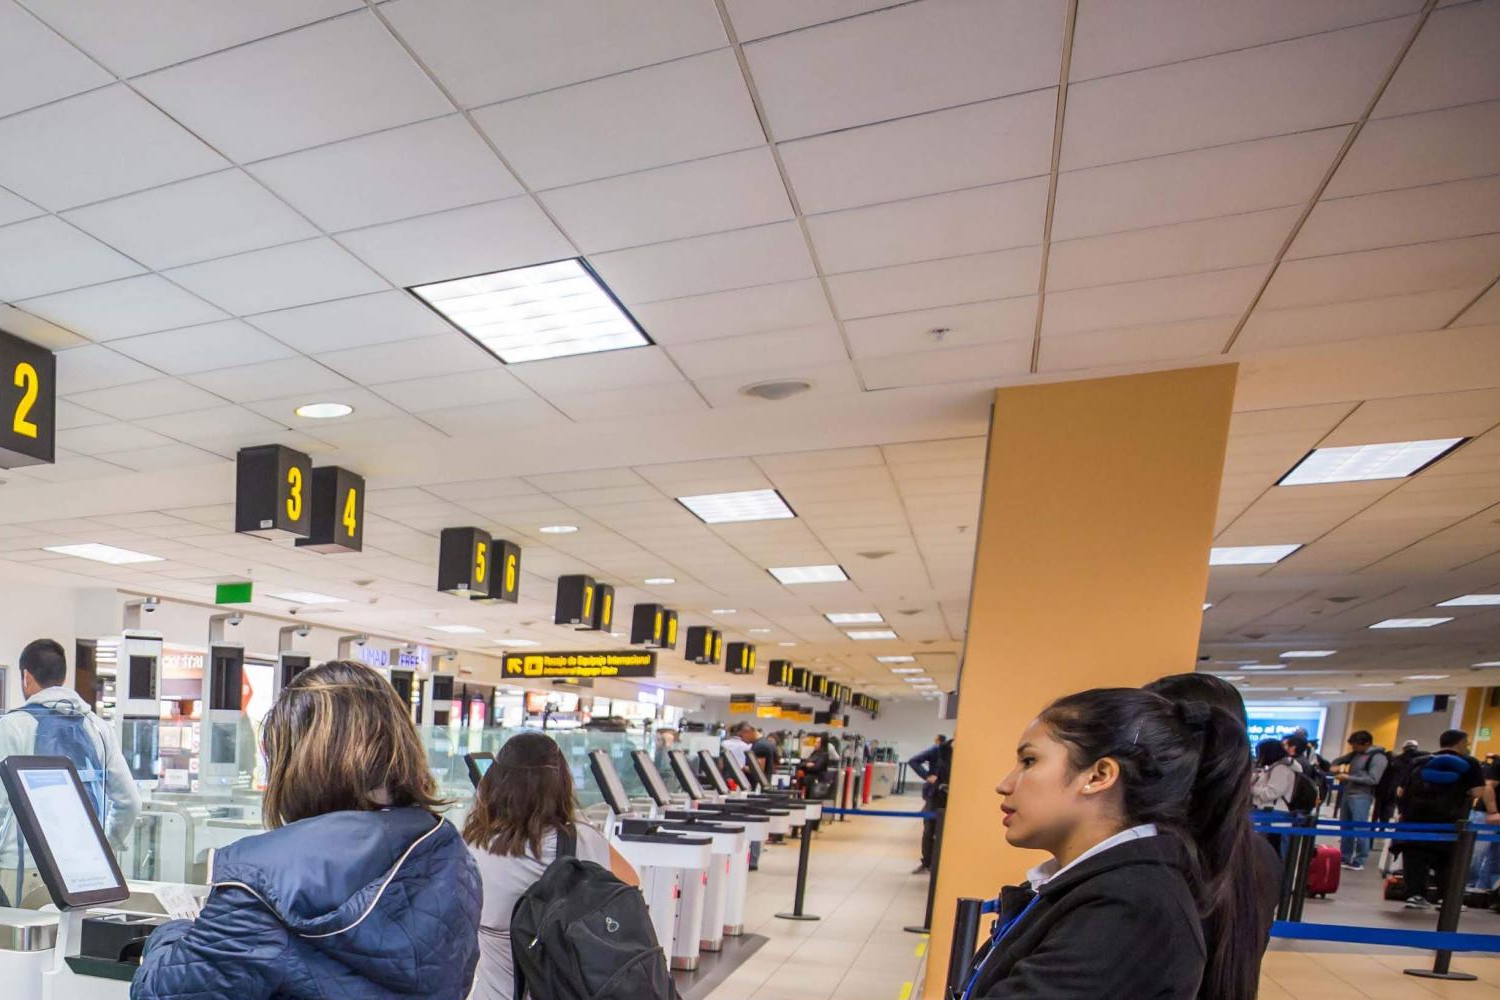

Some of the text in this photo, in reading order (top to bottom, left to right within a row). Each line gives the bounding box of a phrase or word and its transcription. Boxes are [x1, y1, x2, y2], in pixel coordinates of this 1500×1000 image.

[13, 362, 39, 438] 2
[286, 466, 302, 521] 3
[343, 488, 357, 537] 4
[475, 542, 486, 583] 5
[506, 554, 516, 593] 6
[585, 586, 593, 618] 7
[603, 594, 612, 625] 8
